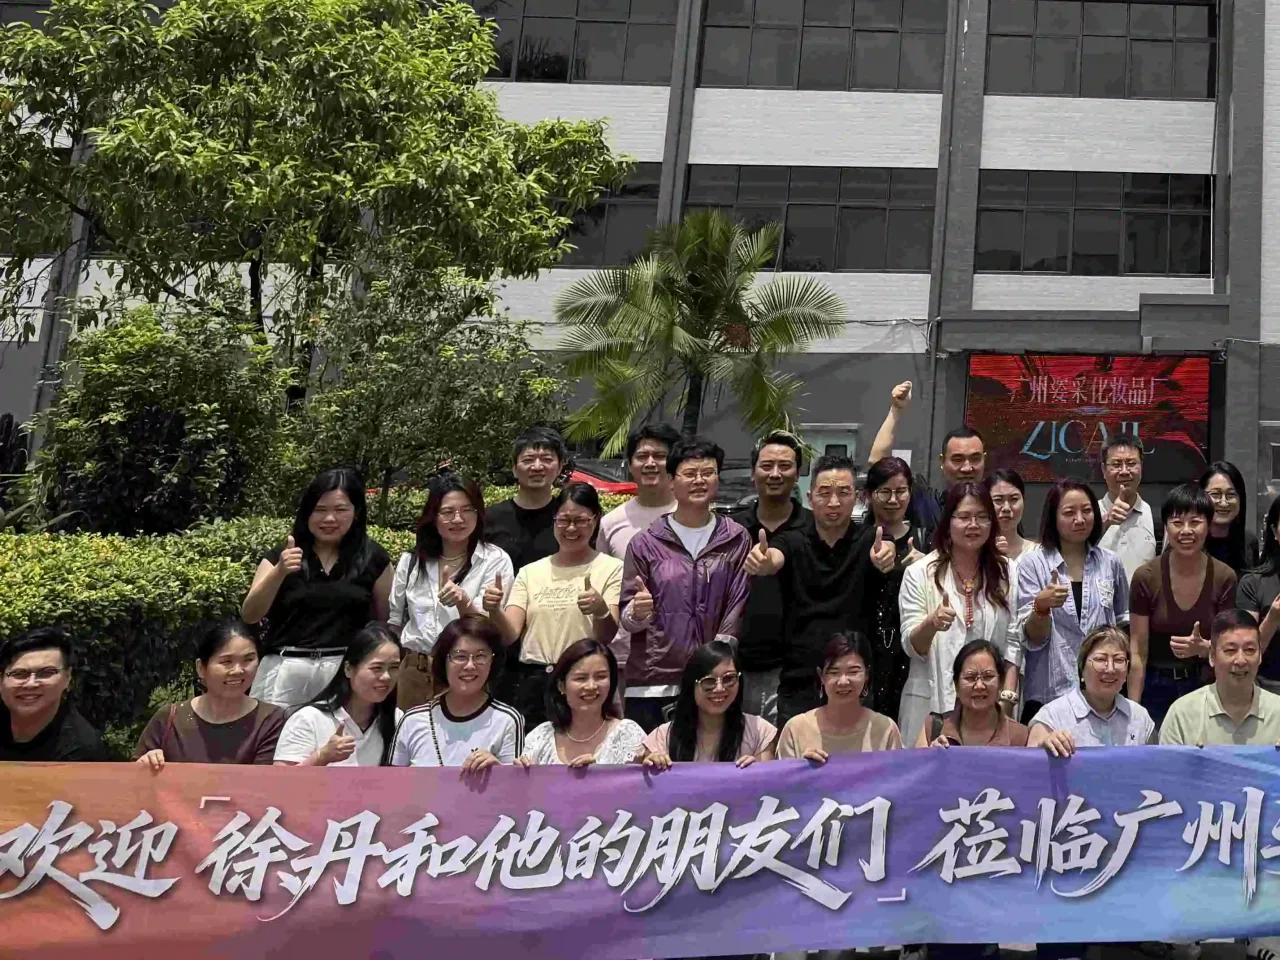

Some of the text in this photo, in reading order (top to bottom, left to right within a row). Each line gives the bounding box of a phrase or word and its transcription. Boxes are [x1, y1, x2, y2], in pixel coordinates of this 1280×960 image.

[1007, 376, 1169, 405] 广州姿采化妆品厂
